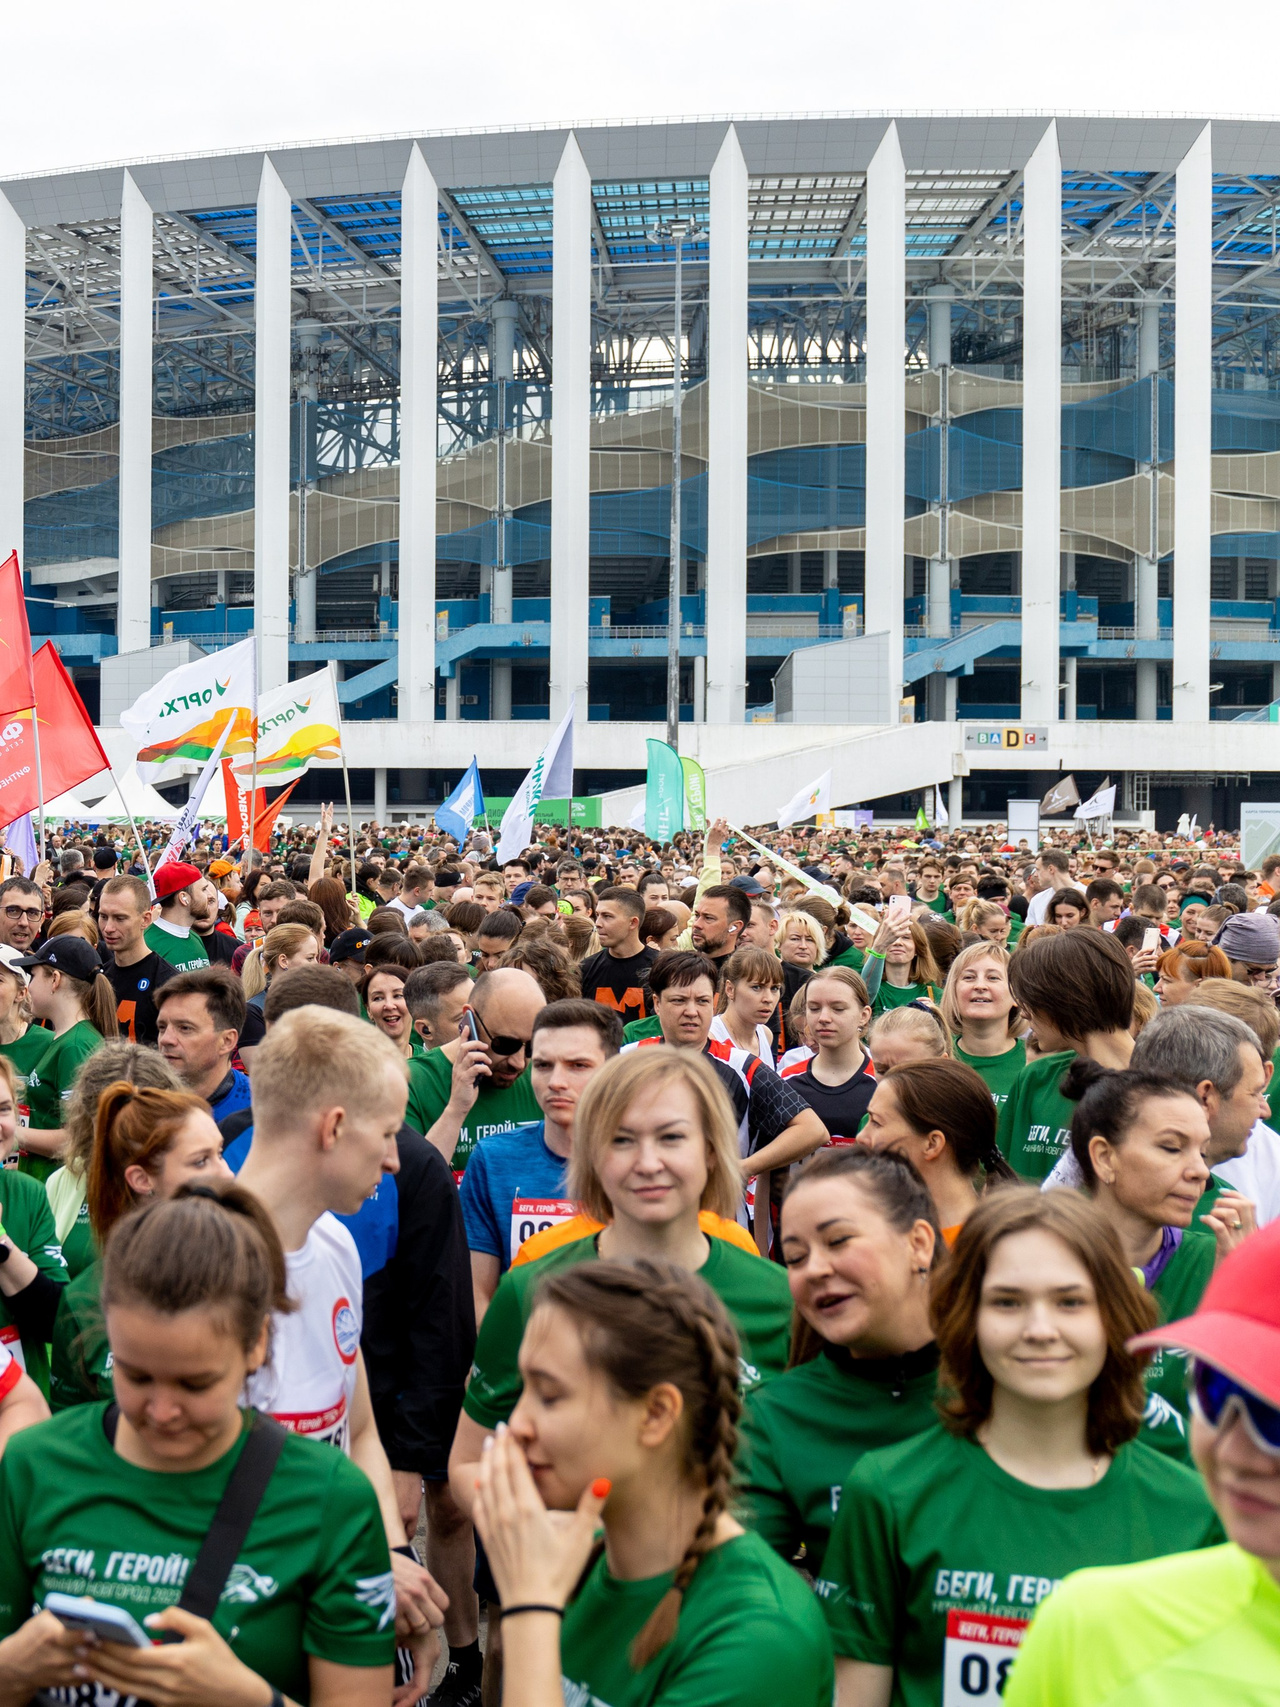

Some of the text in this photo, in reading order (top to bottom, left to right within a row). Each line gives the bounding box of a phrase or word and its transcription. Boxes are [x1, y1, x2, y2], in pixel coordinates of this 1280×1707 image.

[979, 730, 1034, 747] B A D C
[140, 978, 148, 990] D
[536, 1204, 556, 1213] ГЕРОЙ!
[104, 1551, 190, 1586] ГЕРОЙ!
[935, 1569, 998, 1605] БЕГИ,
